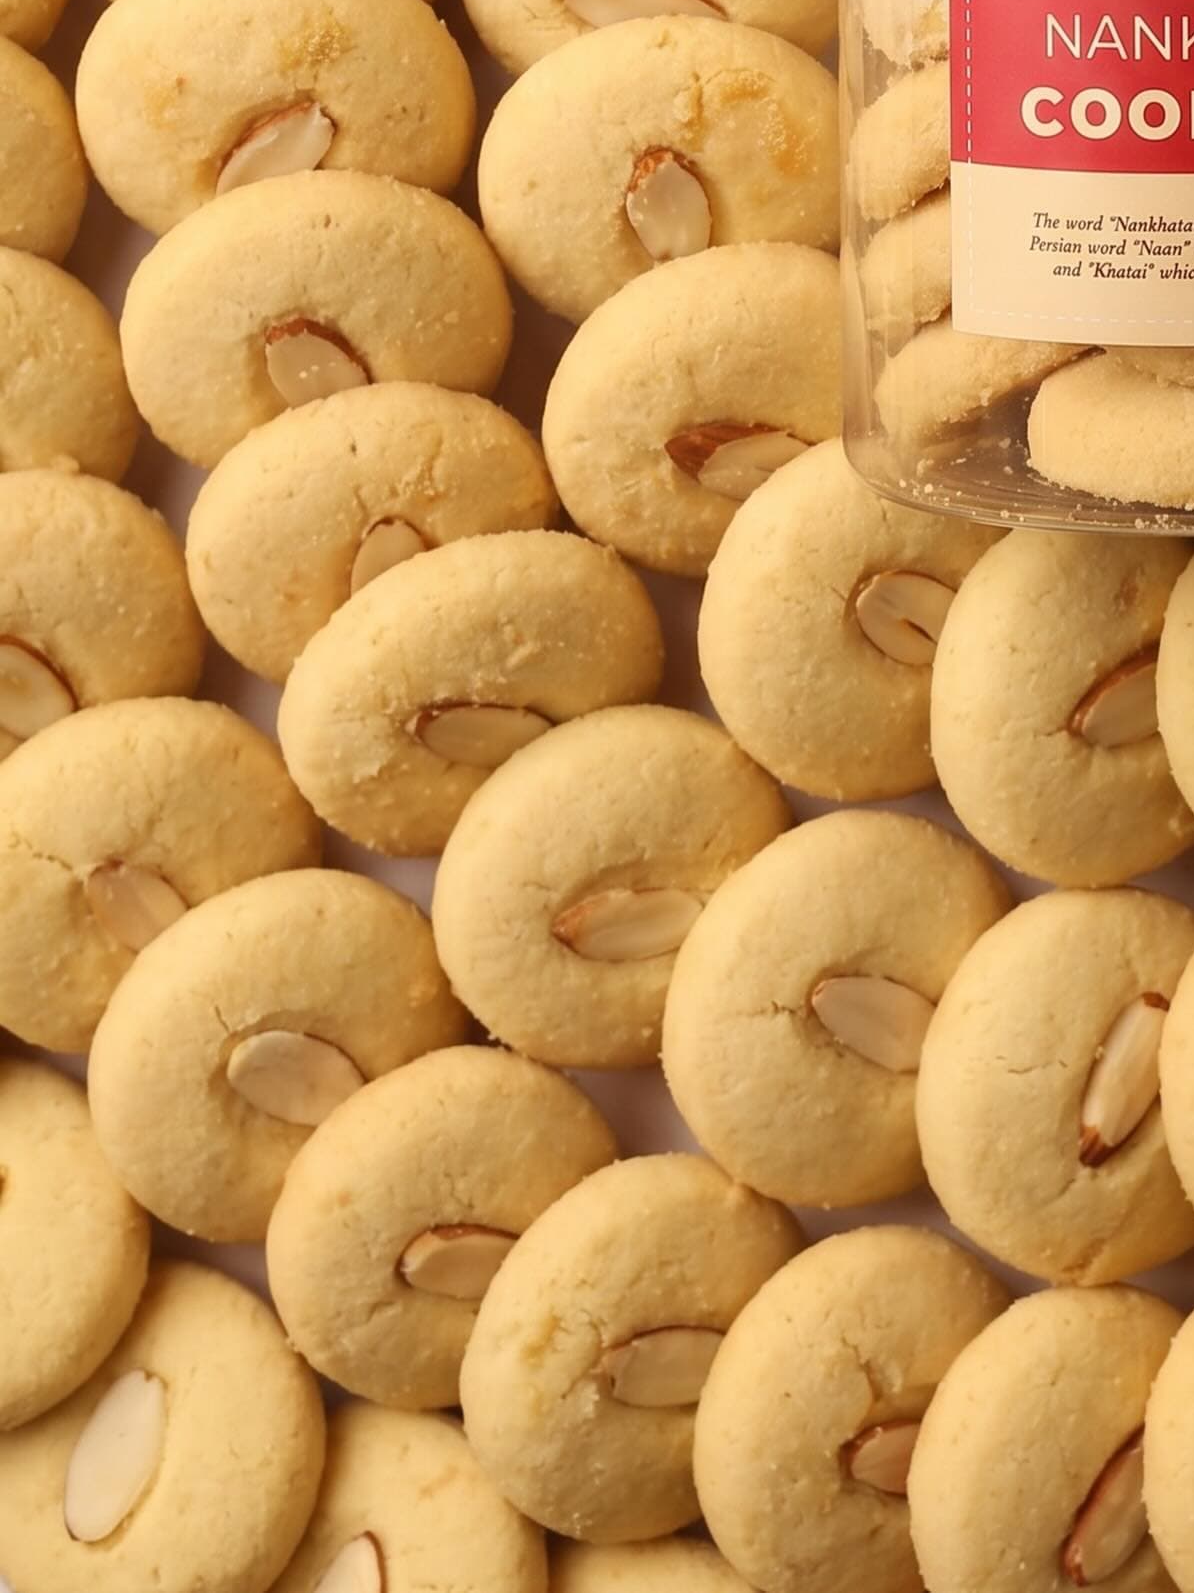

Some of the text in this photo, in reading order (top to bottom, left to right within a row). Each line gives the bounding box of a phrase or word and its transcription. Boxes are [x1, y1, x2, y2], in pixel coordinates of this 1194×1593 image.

[1033, 212, 1060, 229] The
[1066, 215, 1103, 231] word
[1029, 235, 1082, 253] Persian
[1088, 239, 1127, 256] word
[1052, 261, 1082, 277] and
